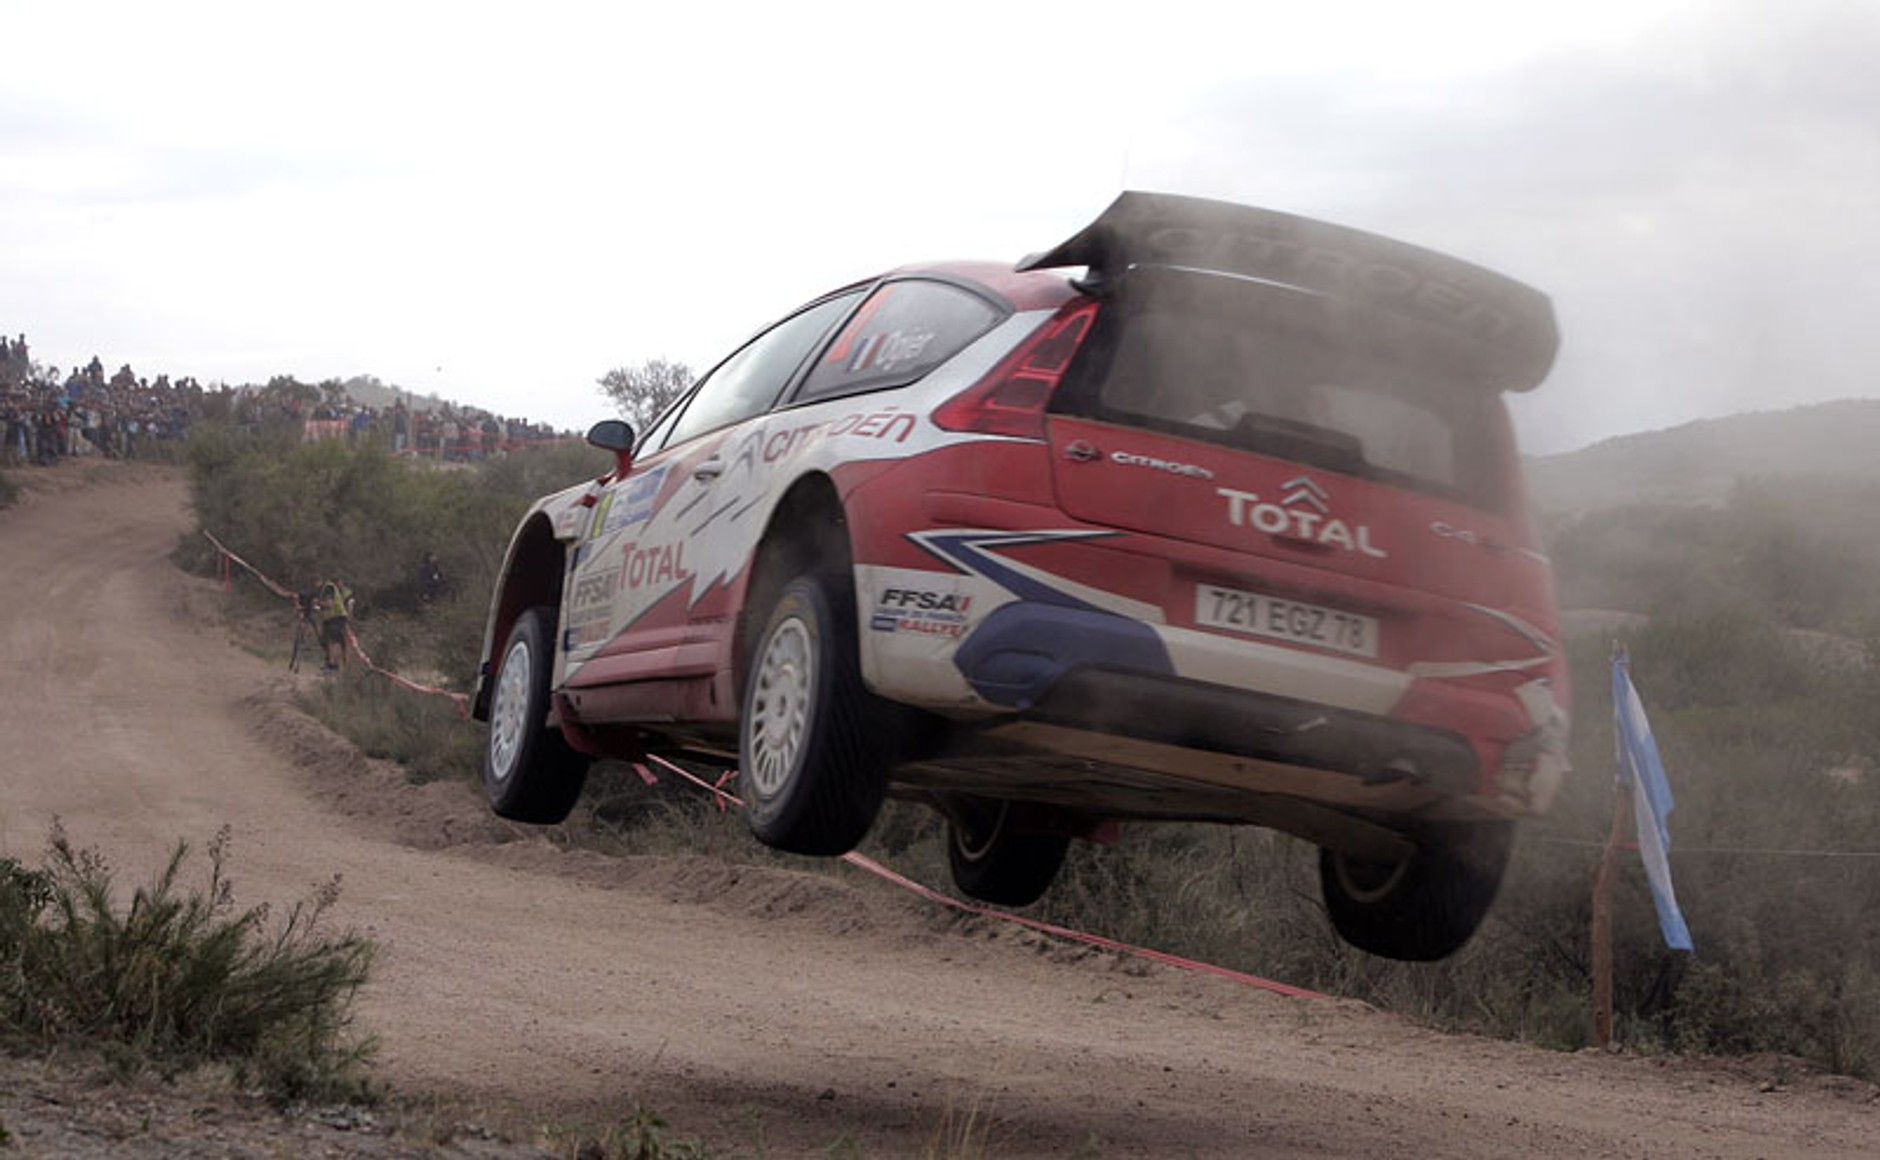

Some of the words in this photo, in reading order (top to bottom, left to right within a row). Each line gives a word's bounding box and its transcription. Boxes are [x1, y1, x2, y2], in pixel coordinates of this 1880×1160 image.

[1217, 487, 1387, 558] TOTAL
[619, 537, 688, 591] TOTAL
[881, 588, 957, 612] FFSA
[1211, 589, 1256, 628] 721
[1268, 602, 1325, 640] EGZ
